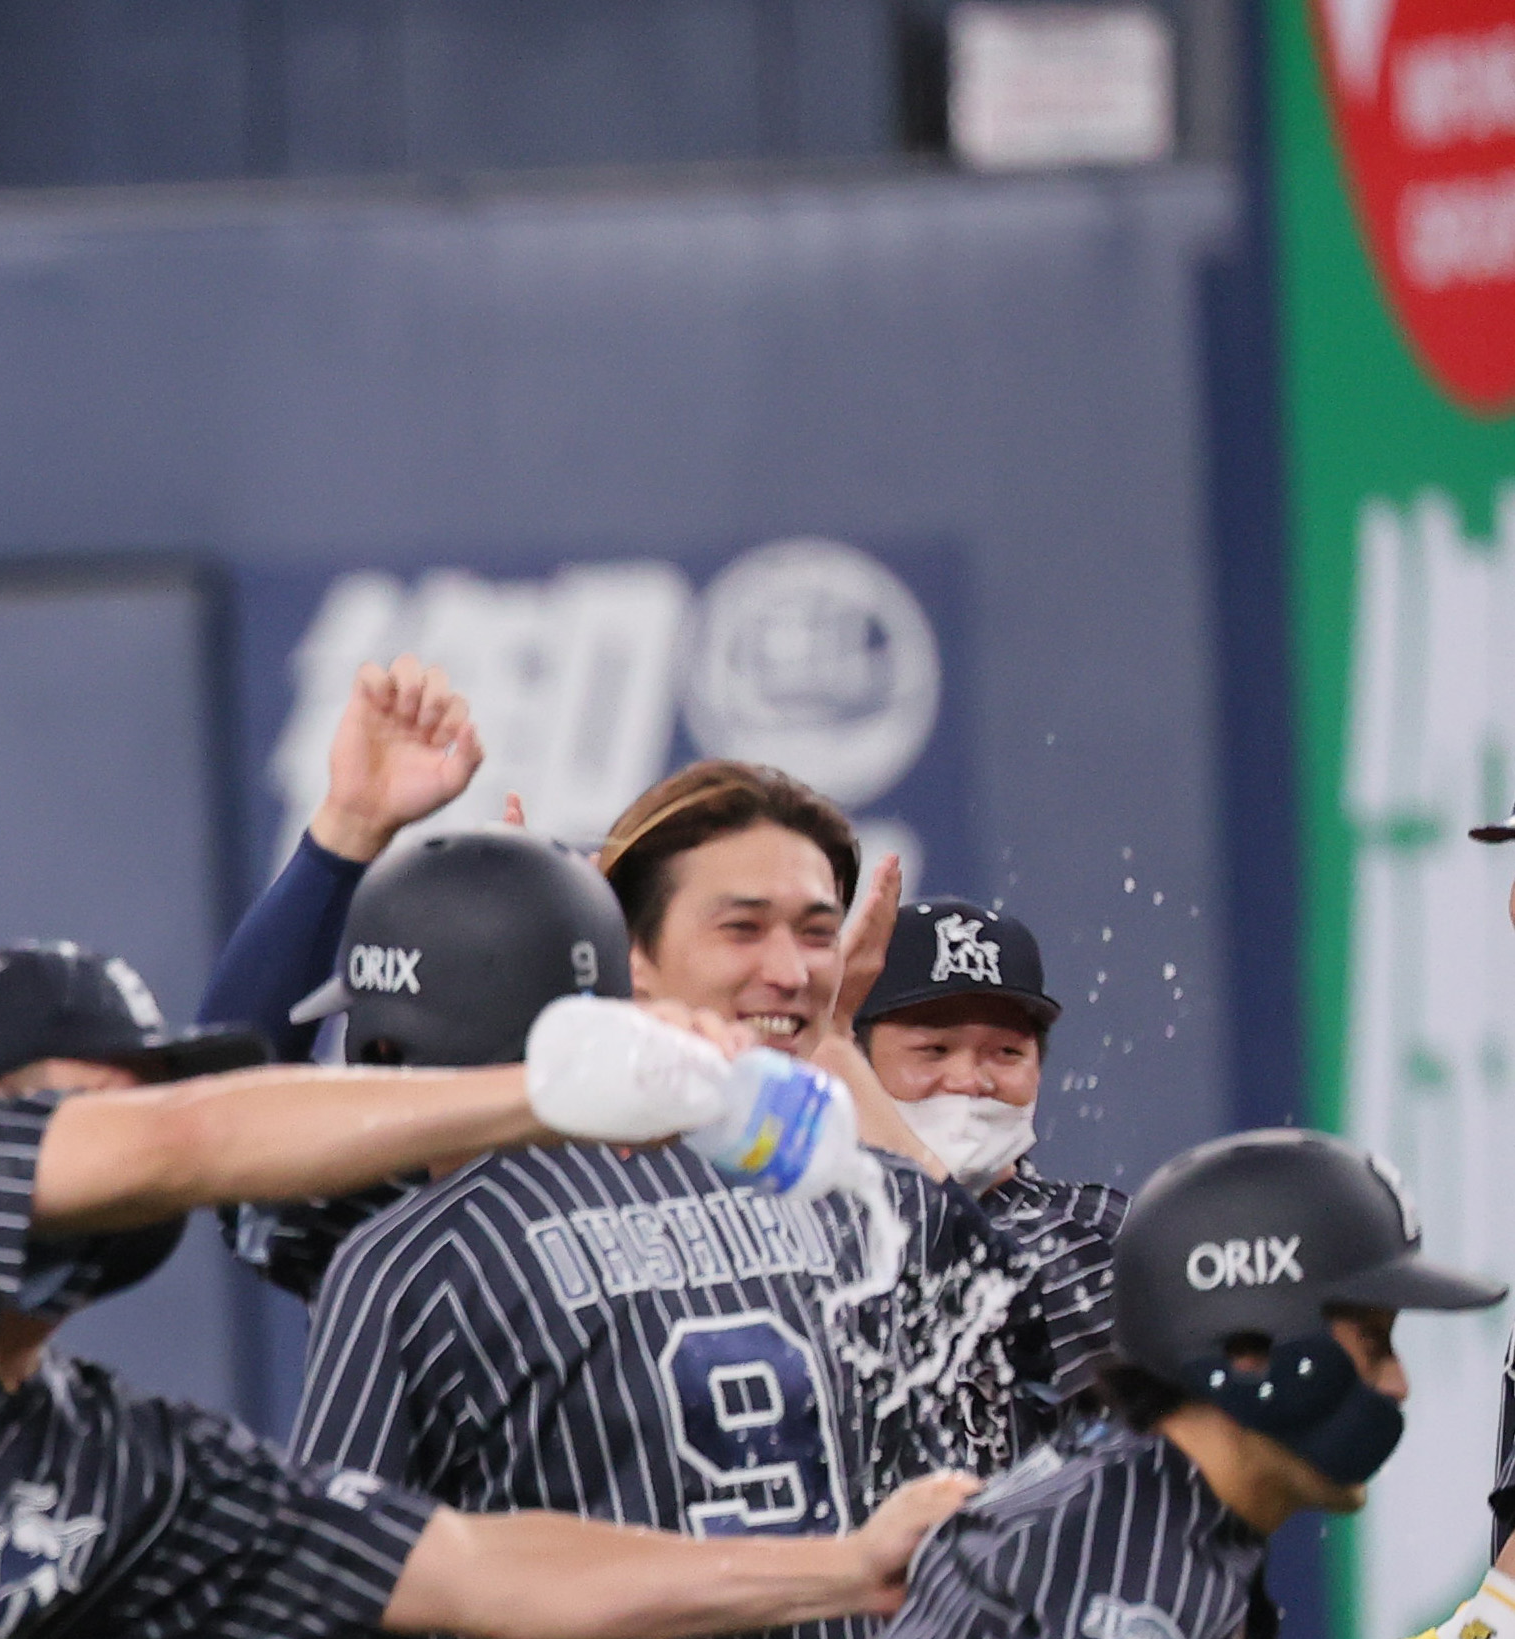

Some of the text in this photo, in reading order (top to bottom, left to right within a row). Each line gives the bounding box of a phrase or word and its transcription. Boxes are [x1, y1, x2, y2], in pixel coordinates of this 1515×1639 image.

[349, 943, 423, 995] ORIX
[570, 940, 599, 988] 9
[1186, 1234, 1305, 1292] ORIX
[659, 1308, 850, 1539] 9
